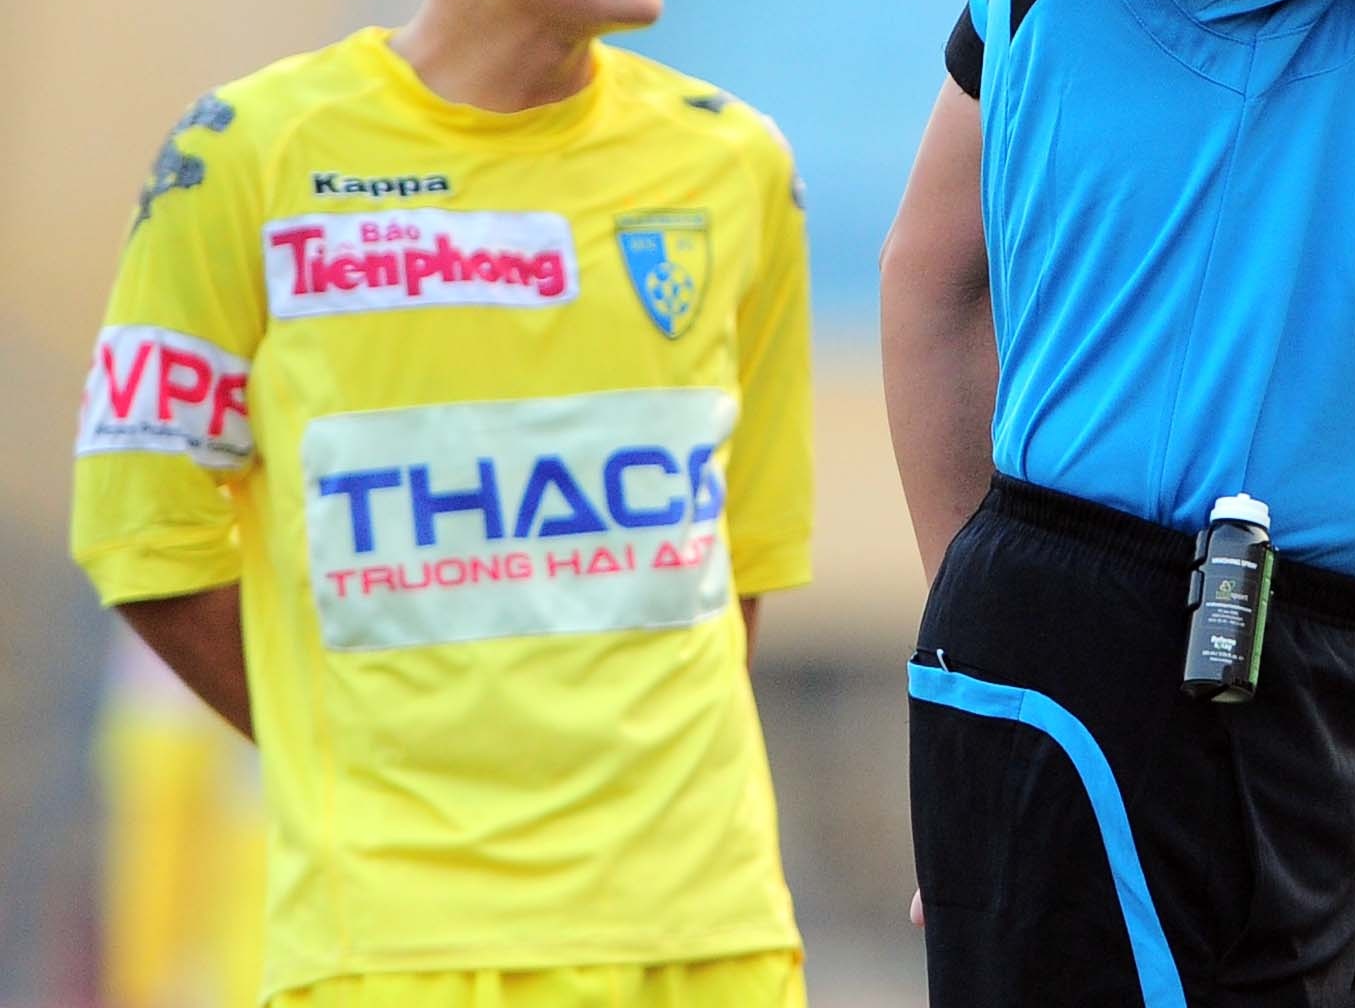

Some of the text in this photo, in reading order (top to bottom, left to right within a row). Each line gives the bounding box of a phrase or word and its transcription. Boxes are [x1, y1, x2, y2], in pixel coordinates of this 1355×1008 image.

[312, 172, 450, 198] Kappa
[326, 552, 534, 598] TRUONG
[545, 542, 635, 578] HAI
